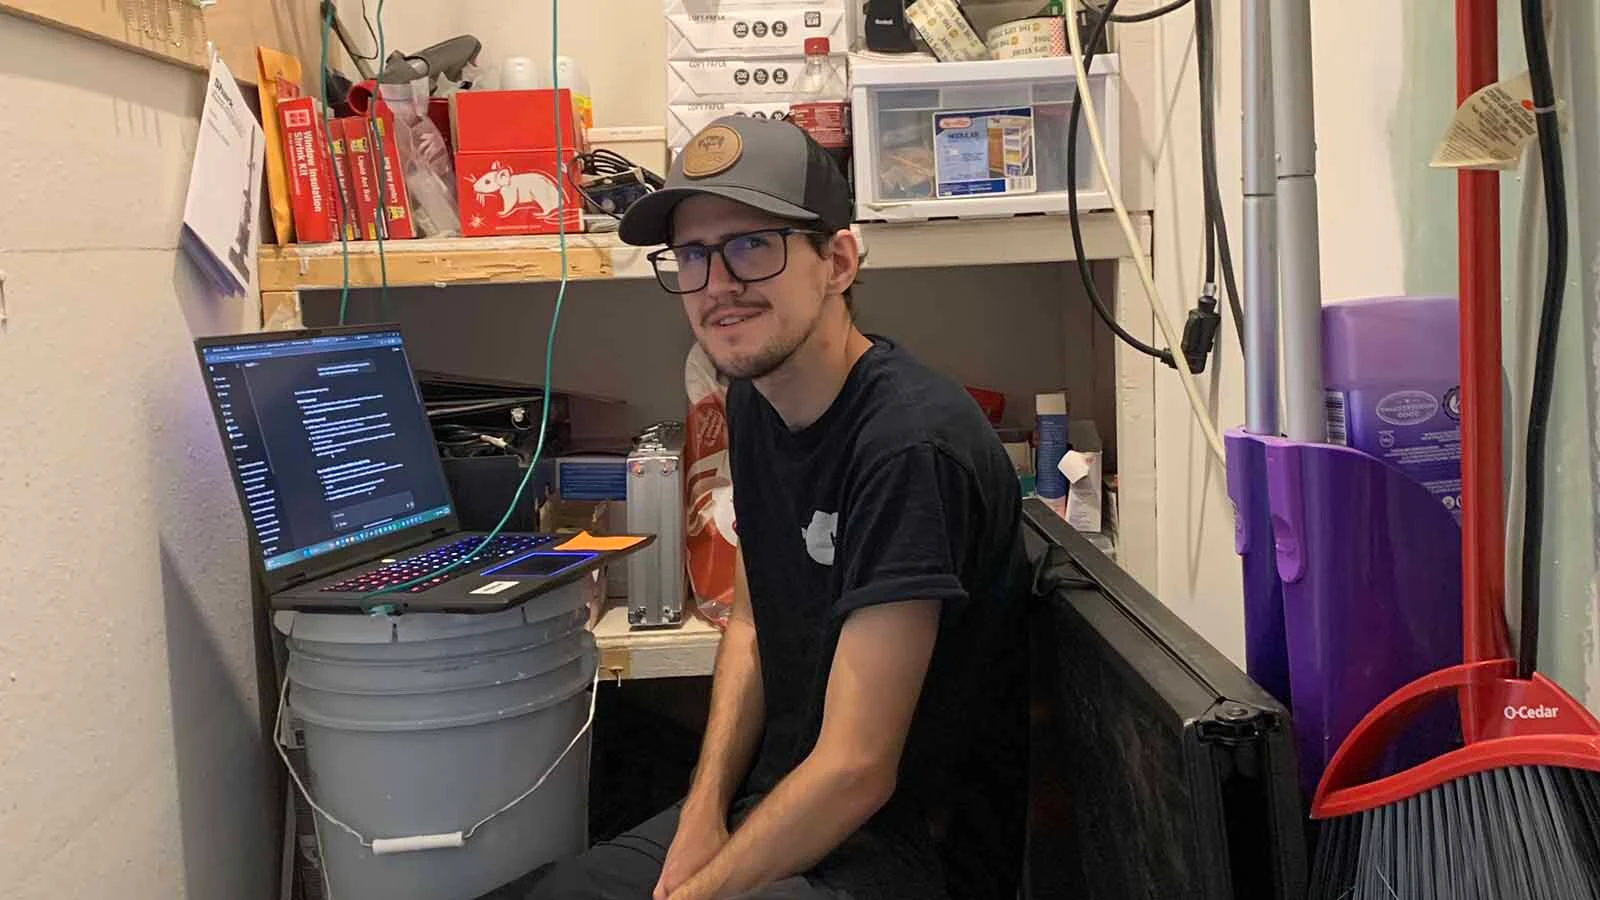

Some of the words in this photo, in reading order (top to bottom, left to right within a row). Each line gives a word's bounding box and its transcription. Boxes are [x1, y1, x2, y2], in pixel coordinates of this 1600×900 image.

[294, 132, 306, 161] Shrink
[303, 130, 316, 167] Window
[298, 162, 309, 177] Kit
[358, 155, 366, 176] Liquid
[309, 168, 322, 213] Insulation
[361, 176, 369, 188] Ant
[363, 189, 371, 202] Bait
[1503, 704, 1559, 719] O-Cedar
